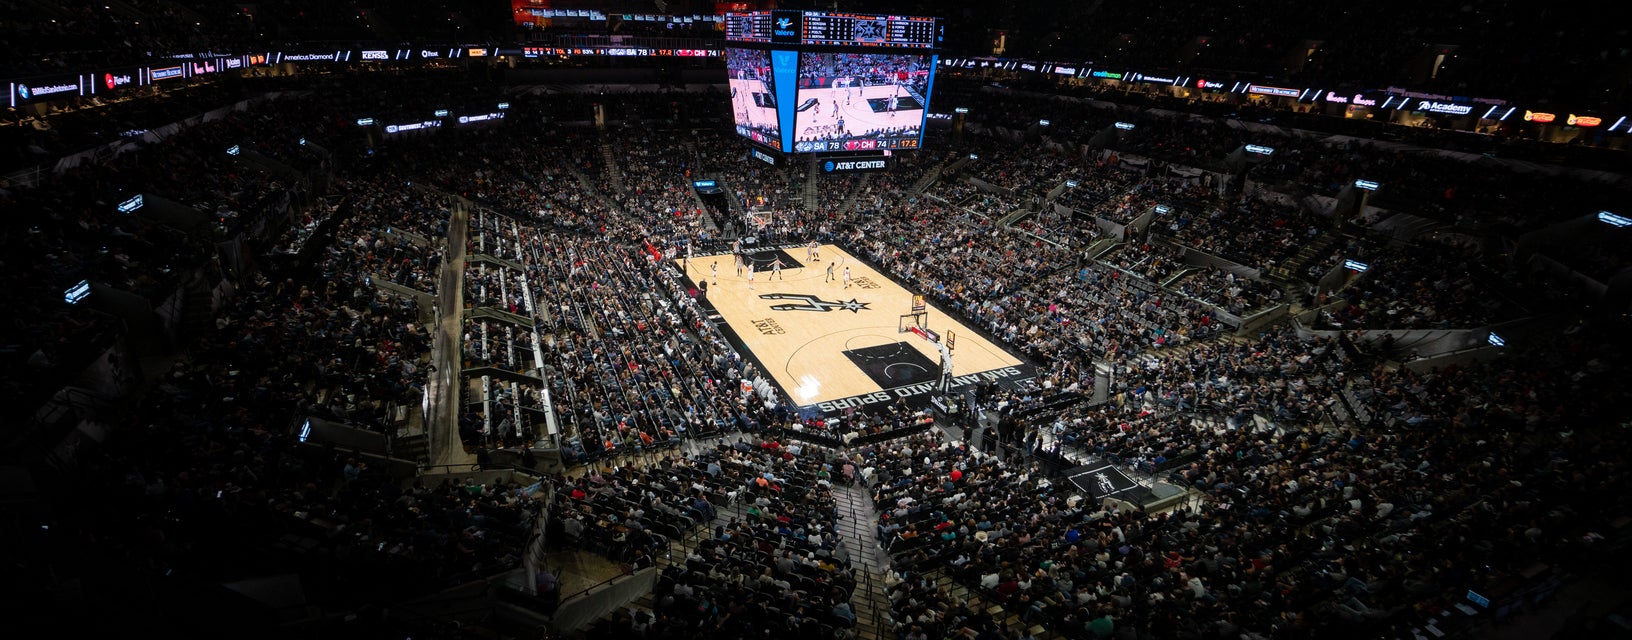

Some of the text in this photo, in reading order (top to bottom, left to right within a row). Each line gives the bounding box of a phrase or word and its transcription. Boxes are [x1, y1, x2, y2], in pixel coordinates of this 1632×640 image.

[1430, 101, 1473, 114] Academy
[814, 141, 840, 150] SA 78
[861, 140, 874, 149] CHI
[877, 140, 887, 148] 74
[900, 139, 917, 147] 17.2
[836, 161, 886, 170] AT&T CENTER
[750, 319, 778, 336] AT&T
[980, 366, 1021, 380] SAN
[820, 390, 892, 413] SPURS
